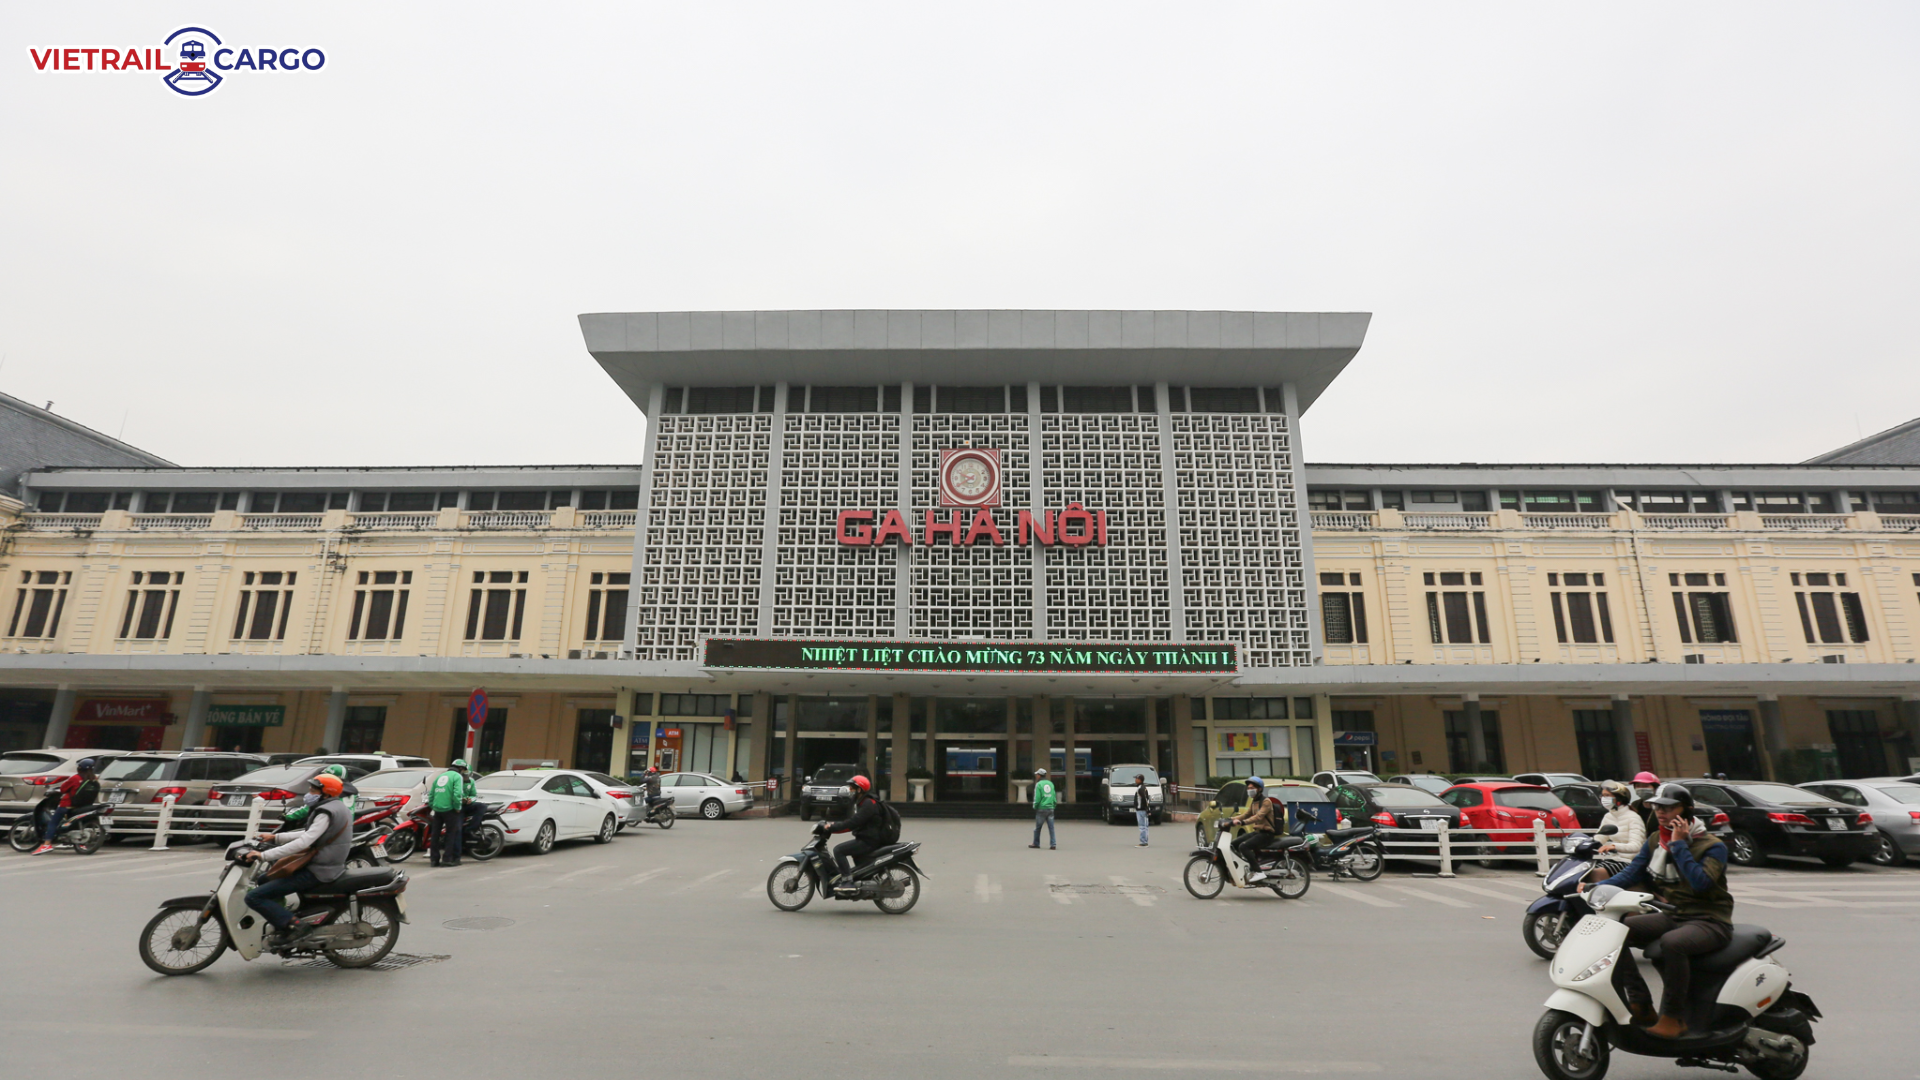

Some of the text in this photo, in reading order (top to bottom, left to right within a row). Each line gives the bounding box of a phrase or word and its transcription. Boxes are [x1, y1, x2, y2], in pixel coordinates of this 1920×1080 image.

[837, 502, 1107, 548] GA HÀ NỘI
[801, 646, 858, 665] NHIỆT
[862, 647, 904, 666] LIỆT
[907, 647, 961, 664] CHÀO
[966, 647, 1022, 665] MỪNG
[1027, 650, 1045, 665] 73
[1049, 648, 1092, 664] NĂM
[1096, 648, 1148, 664] NGÀY
[1153, 648, 1218, 665] THÀNH
[237, 708, 262, 723] BÁN
